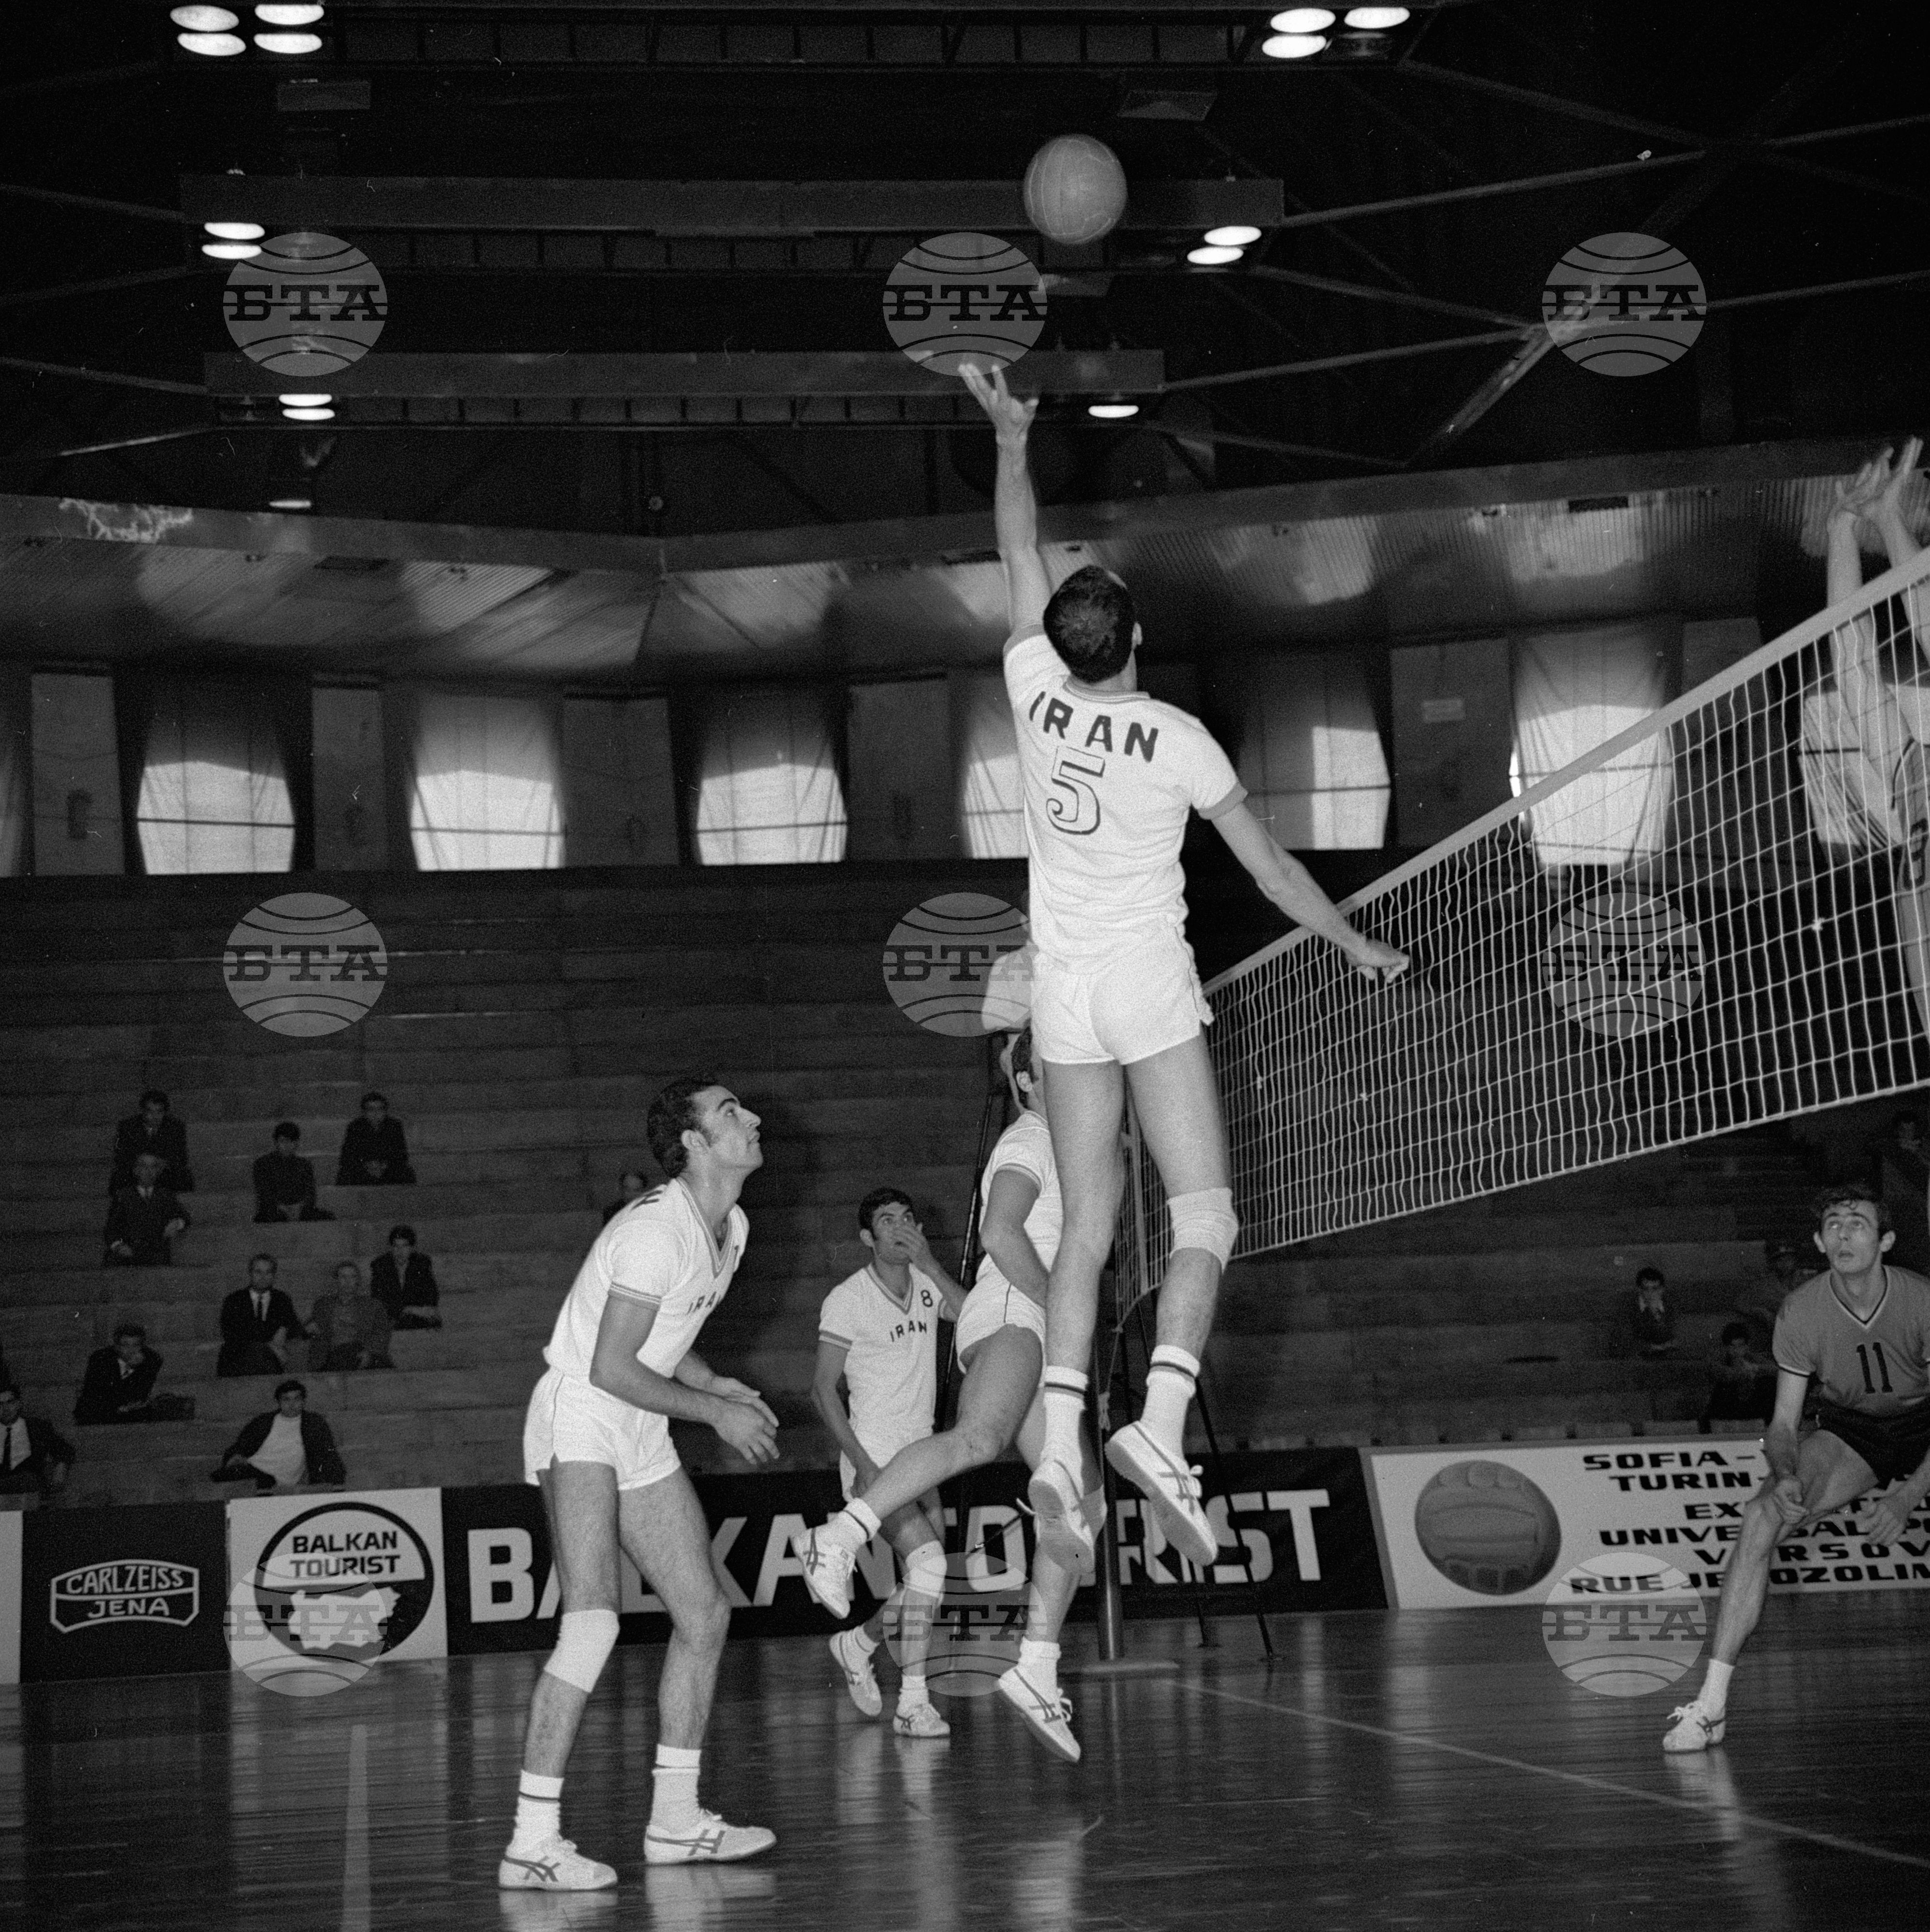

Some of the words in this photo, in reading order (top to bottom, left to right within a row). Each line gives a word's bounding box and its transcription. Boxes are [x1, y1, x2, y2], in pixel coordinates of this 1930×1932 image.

[1030, 691, 1158, 763] IRAN
[1046, 746, 1105, 835] 5
[921, 1290, 933, 1307] 8
[890, 1320, 927, 1343] IRAN
[1857, 1342, 1893, 1394] 11
[293, 1531, 397, 1553] BALKAN
[1694, 1540, 1930, 1565] VRSOV
[290, 1555, 400, 1577] TOURIST
[1570, 1574, 1664, 1593] RUE
[87, 1597, 170, 1618] JENA
